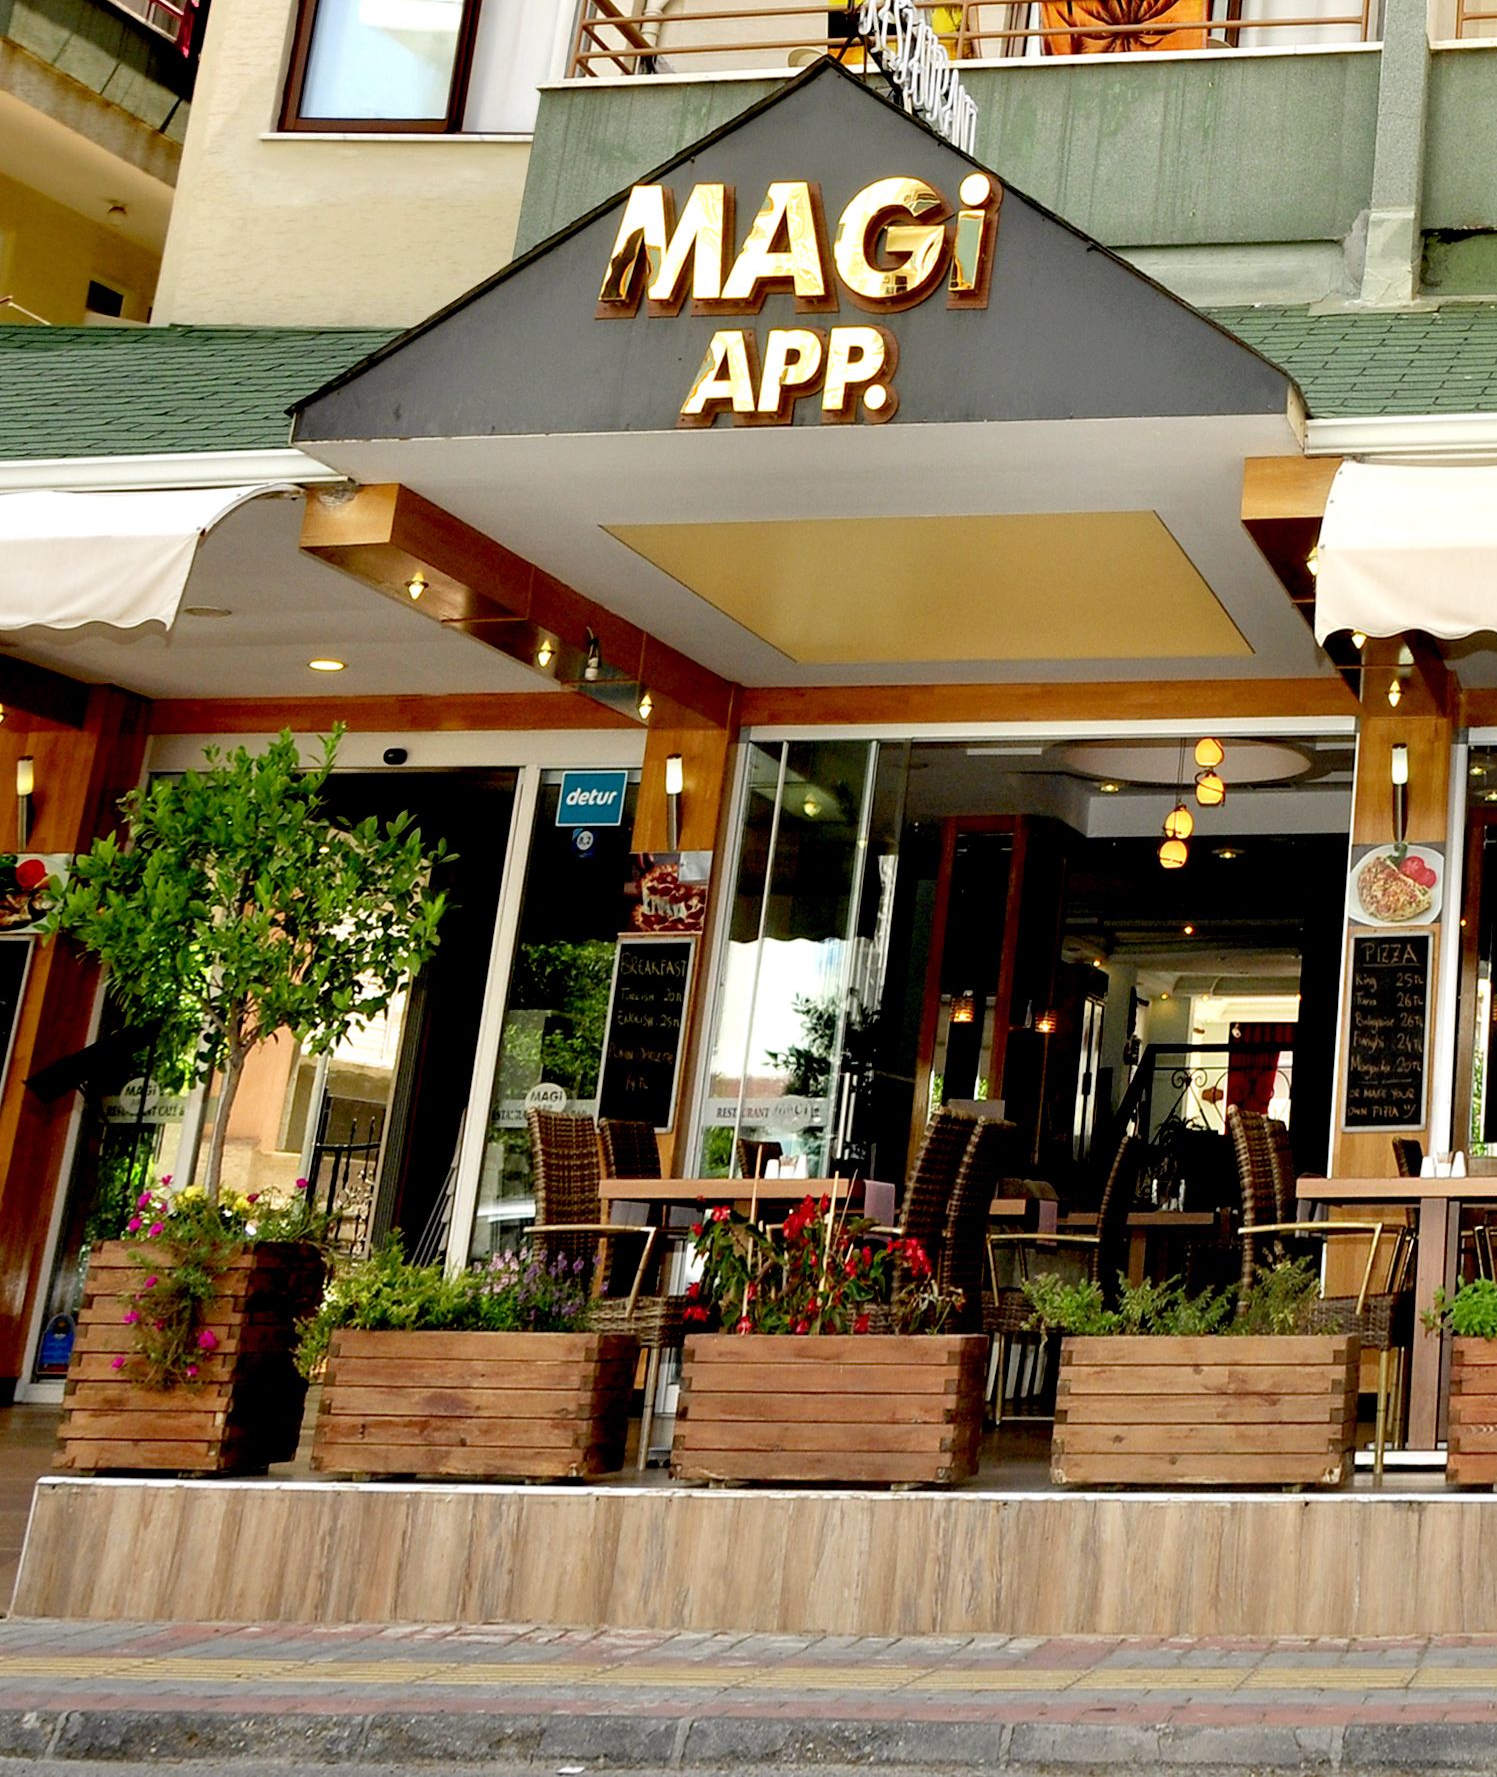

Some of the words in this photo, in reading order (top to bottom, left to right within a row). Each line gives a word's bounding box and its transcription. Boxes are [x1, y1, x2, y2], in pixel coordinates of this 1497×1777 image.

[678, 324, 898, 427] APP.
[565, 787, 618, 806] detur
[620, 951, 687, 977] BREAKFAST
[1361, 942, 1417, 964] PIZZA
